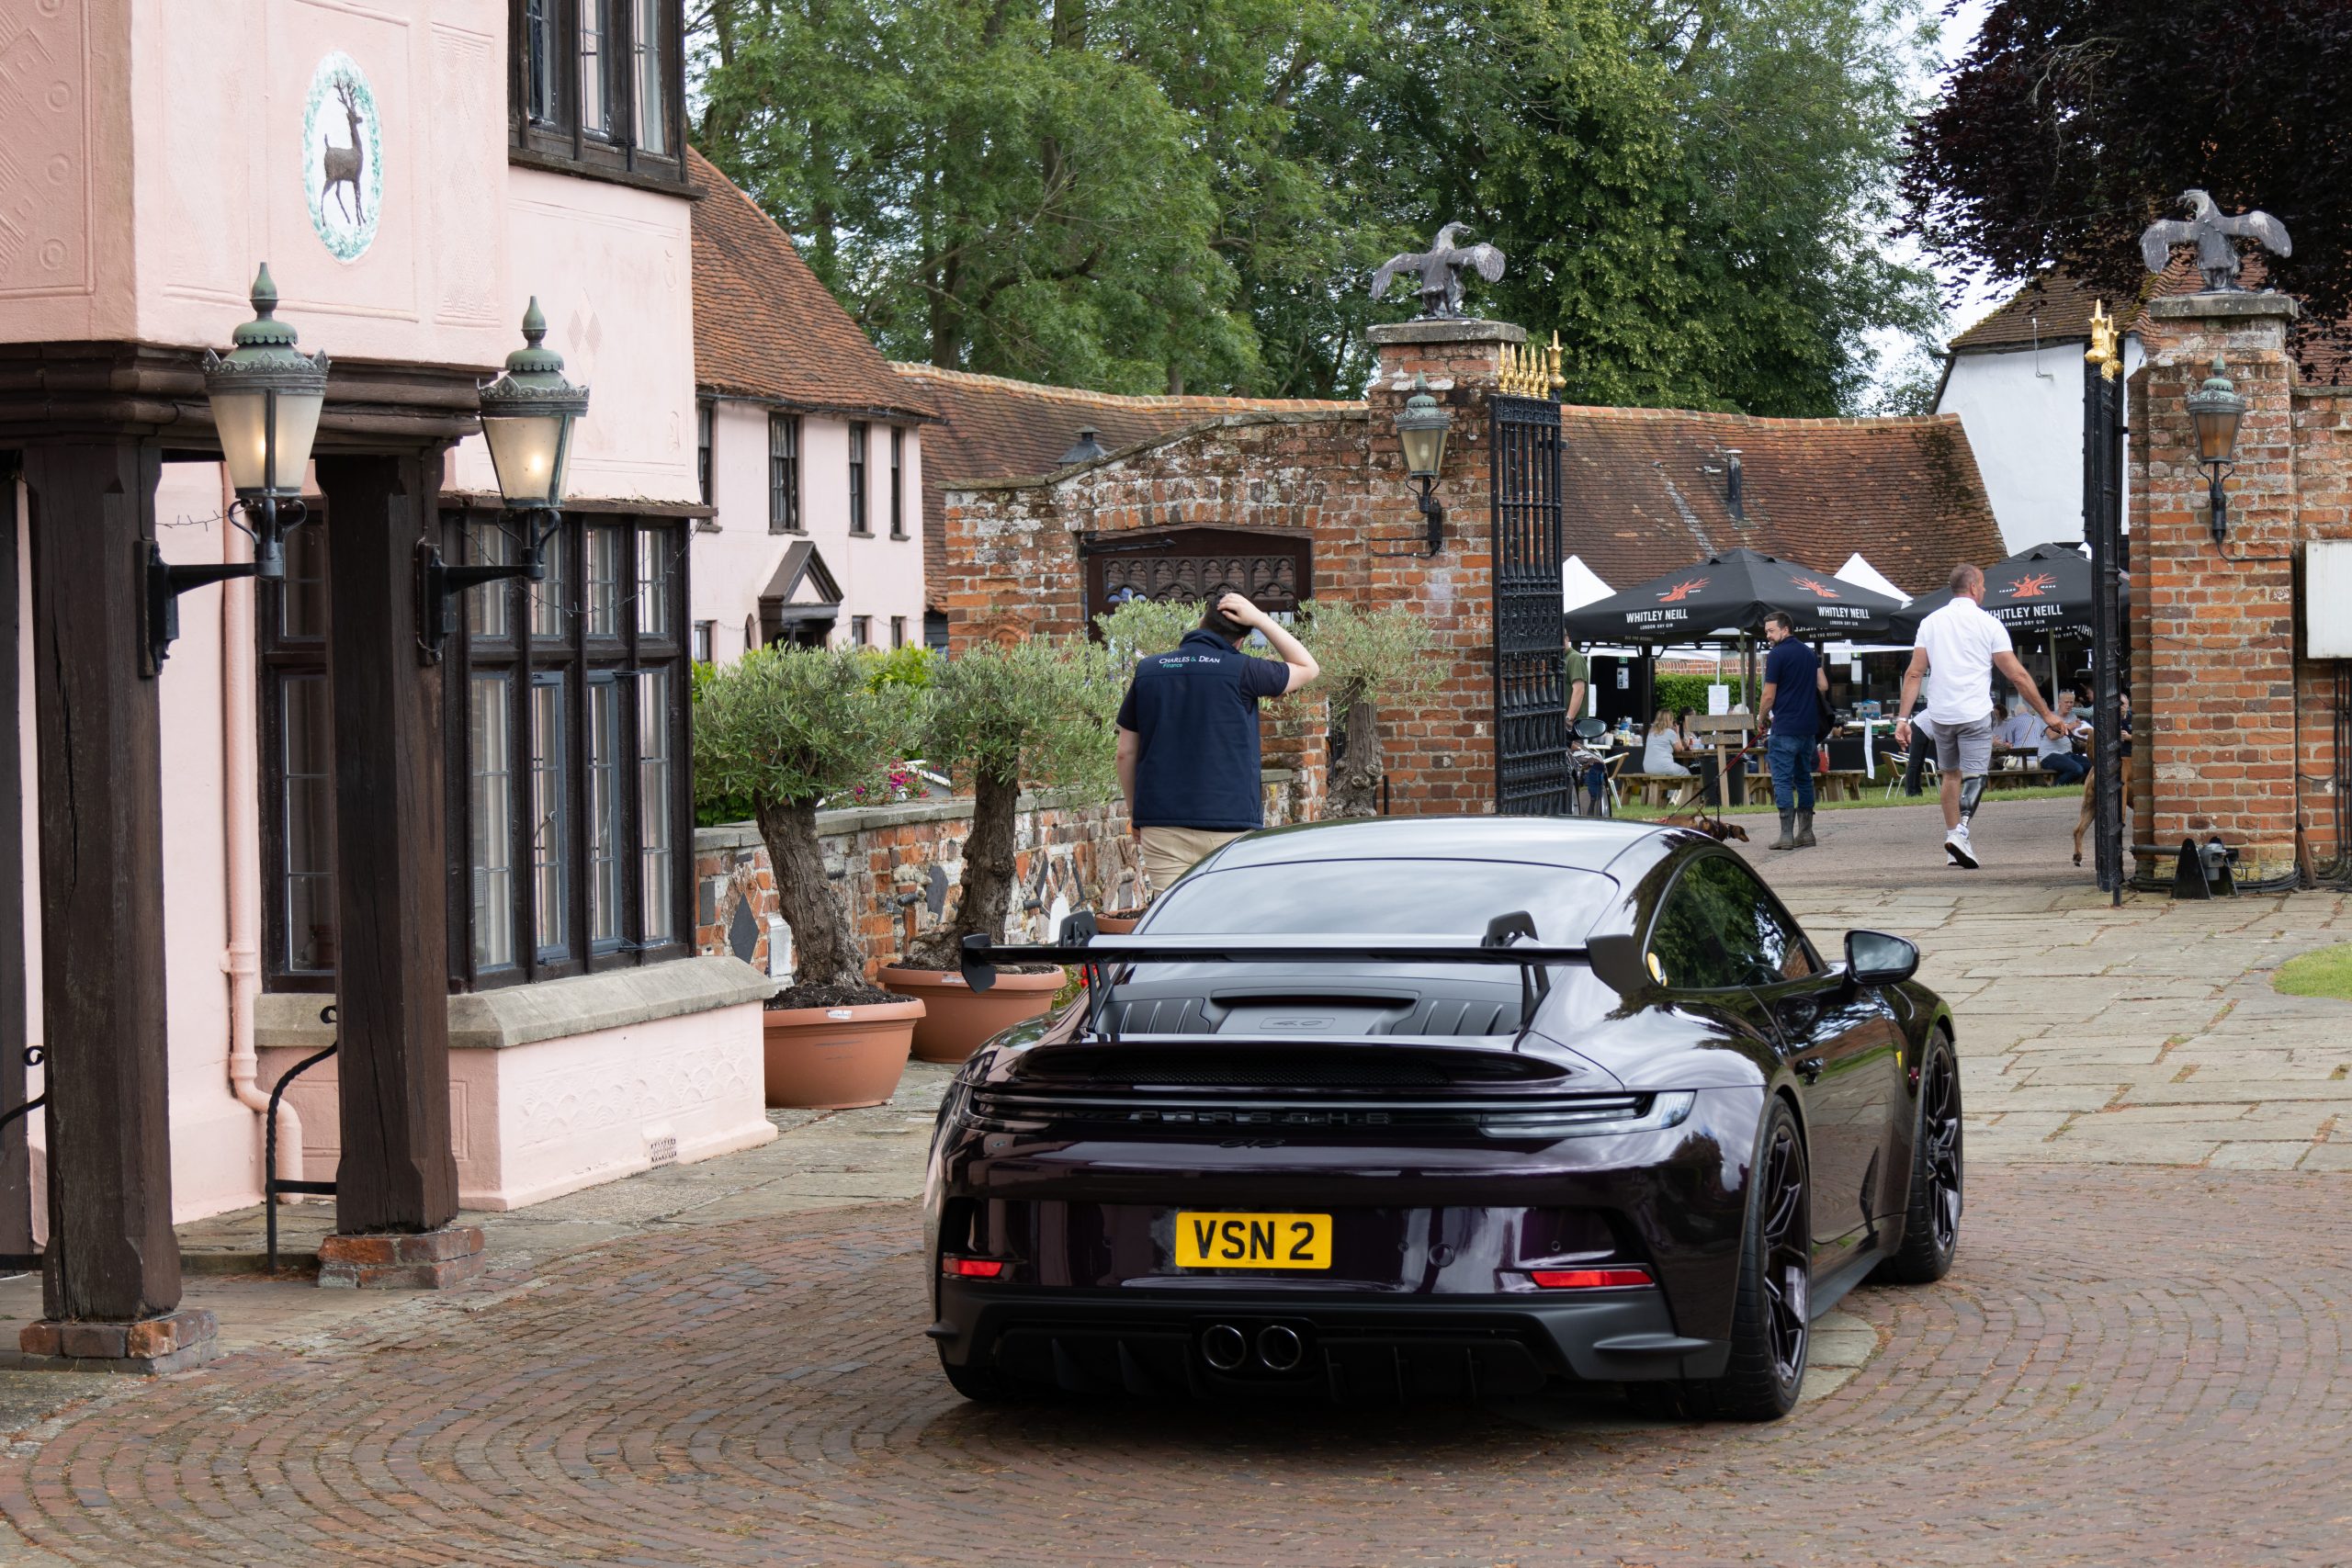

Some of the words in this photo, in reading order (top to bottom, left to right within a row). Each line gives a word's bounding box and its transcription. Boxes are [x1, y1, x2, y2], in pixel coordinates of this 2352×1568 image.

[1626, 610, 1663, 623] WHITLEY
[1665, 608, 1688, 620] NEILL
[1817, 605, 1849, 618] WHITLEY
[1849, 607, 1870, 619] NEILL
[2033, 604, 2063, 617] NEILL
[1198, 655, 1221, 663] DEAN
[1138, 1110, 1390, 1124] PORSCHE
[1193, 1220, 1275, 1259] VSN
[1289, 1221, 1315, 1260] 2
